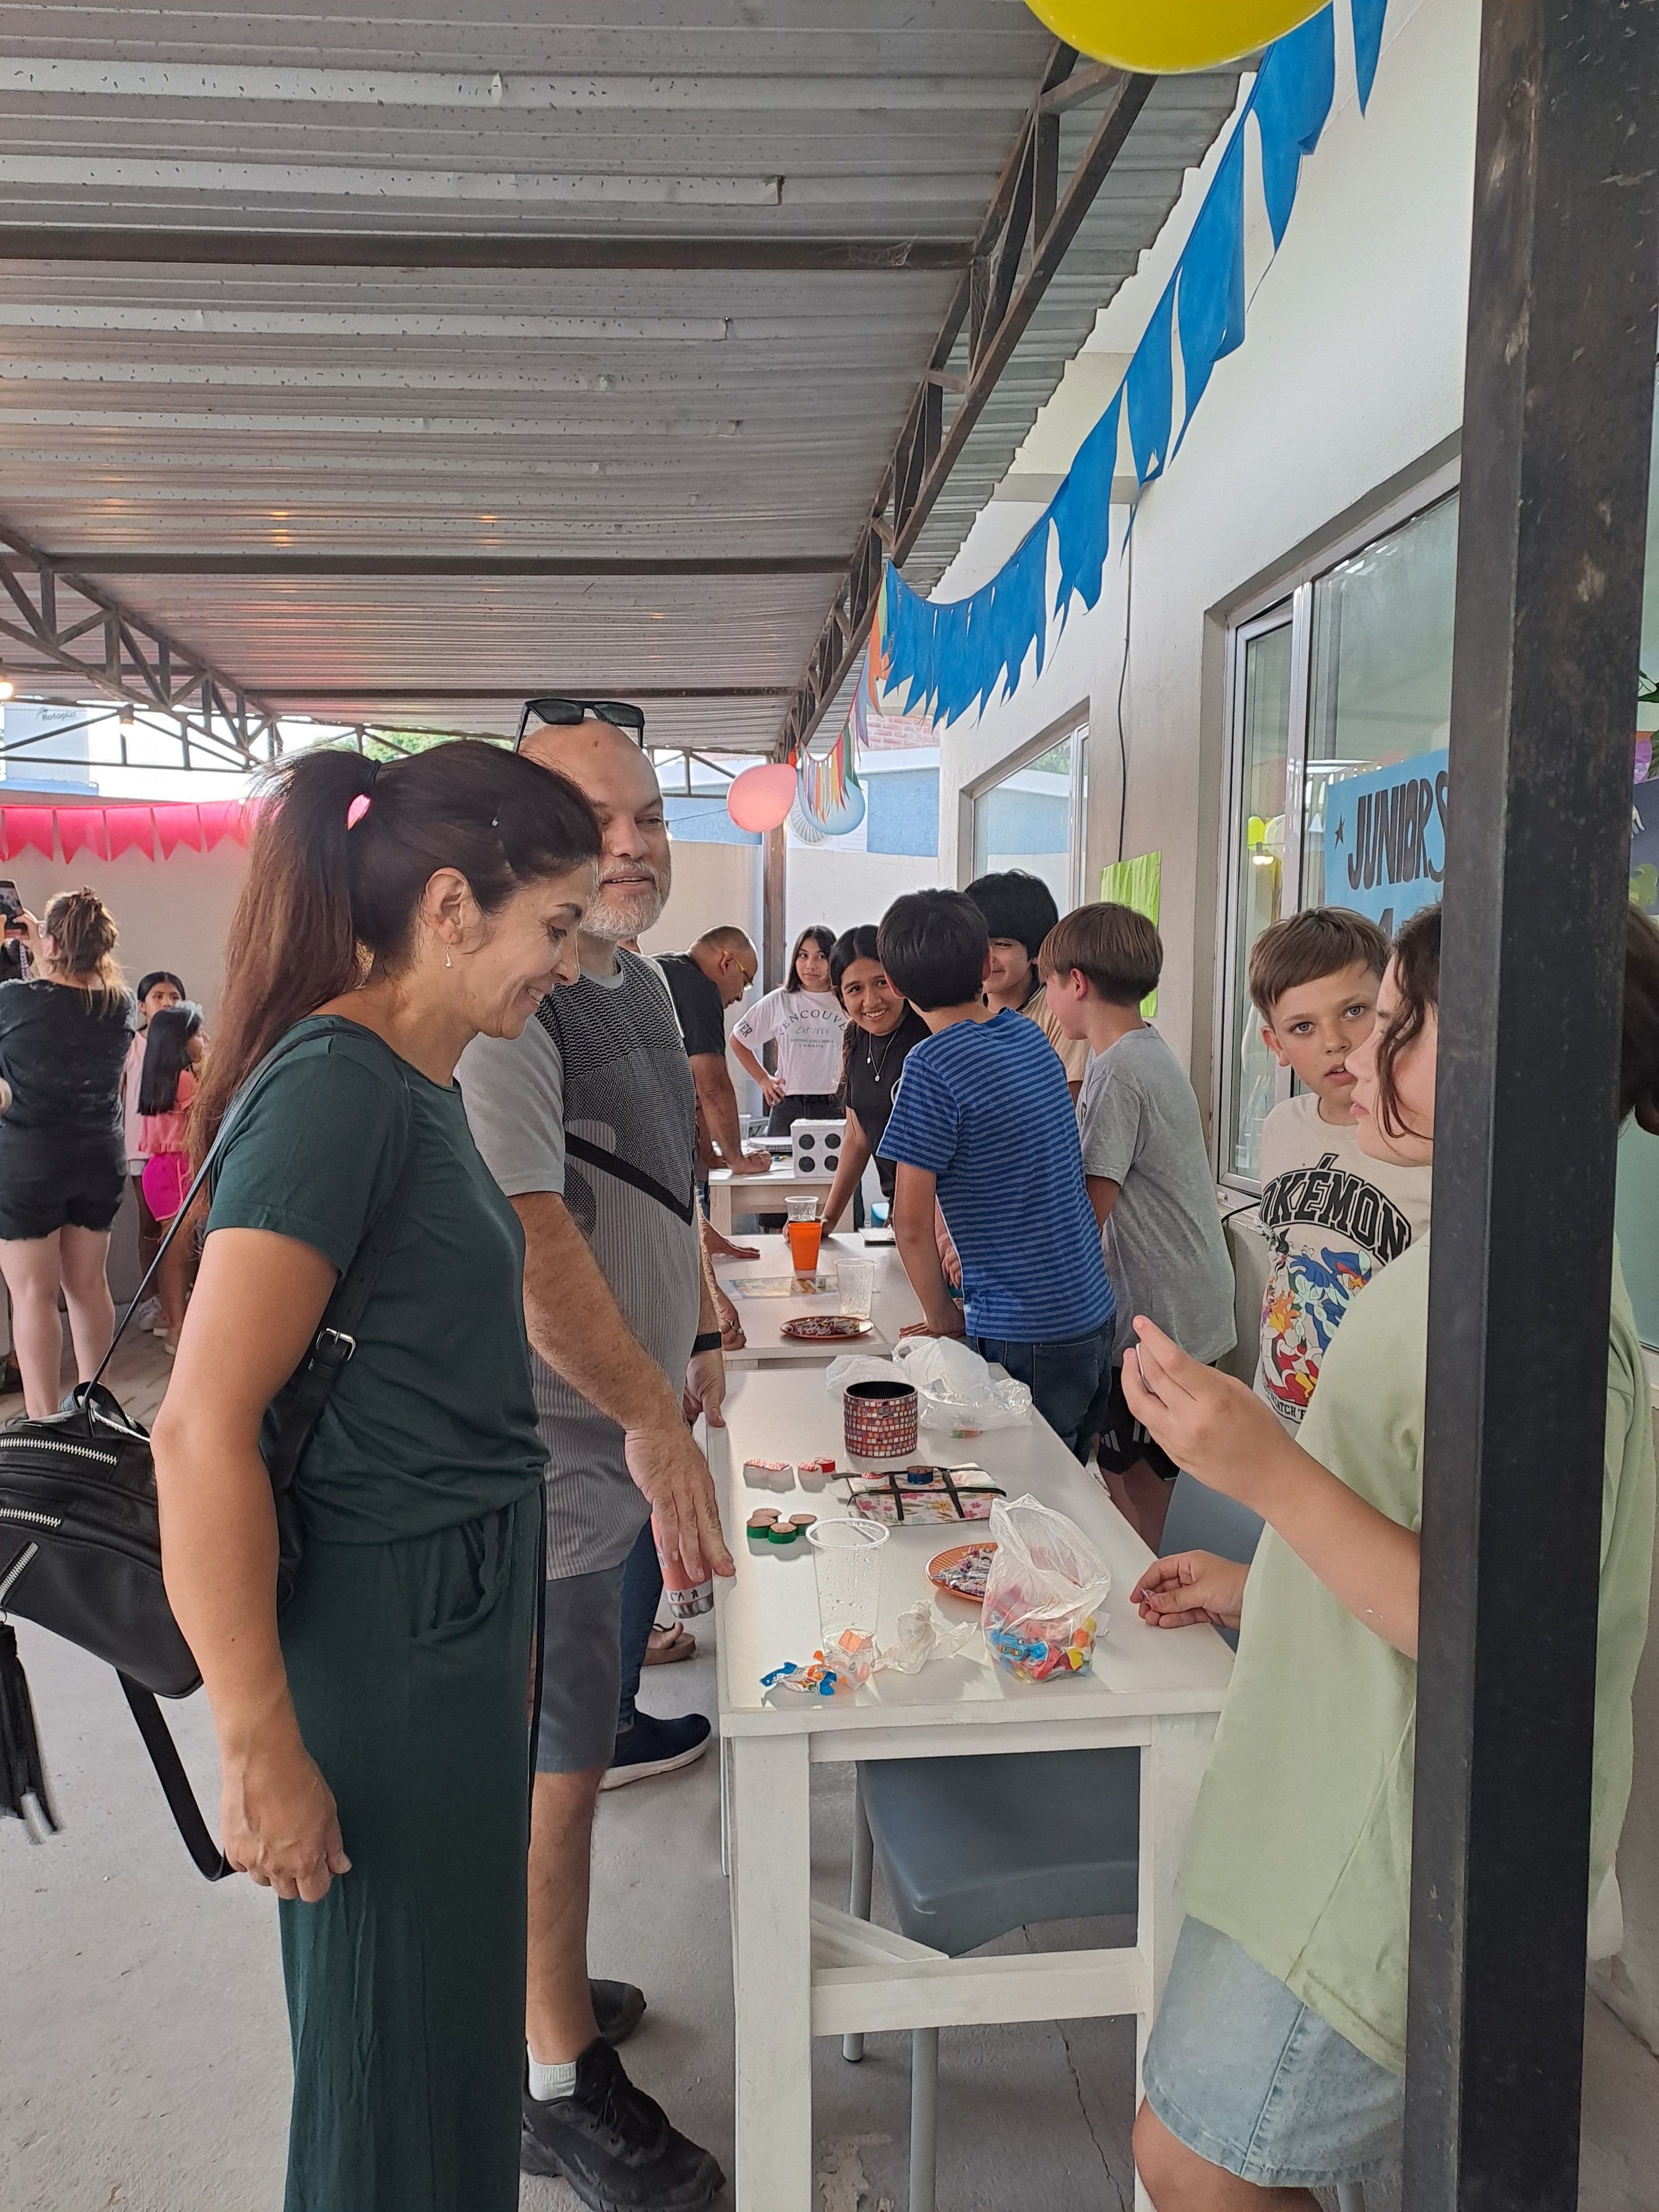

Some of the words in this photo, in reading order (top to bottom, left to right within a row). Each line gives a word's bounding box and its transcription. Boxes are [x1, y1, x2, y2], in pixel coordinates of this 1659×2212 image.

[1348, 770, 1448, 890] JUNIORS
[779, 1009, 847, 1036] VENCOUVE
[1260, 1152, 1412, 1267] OKÉMON
